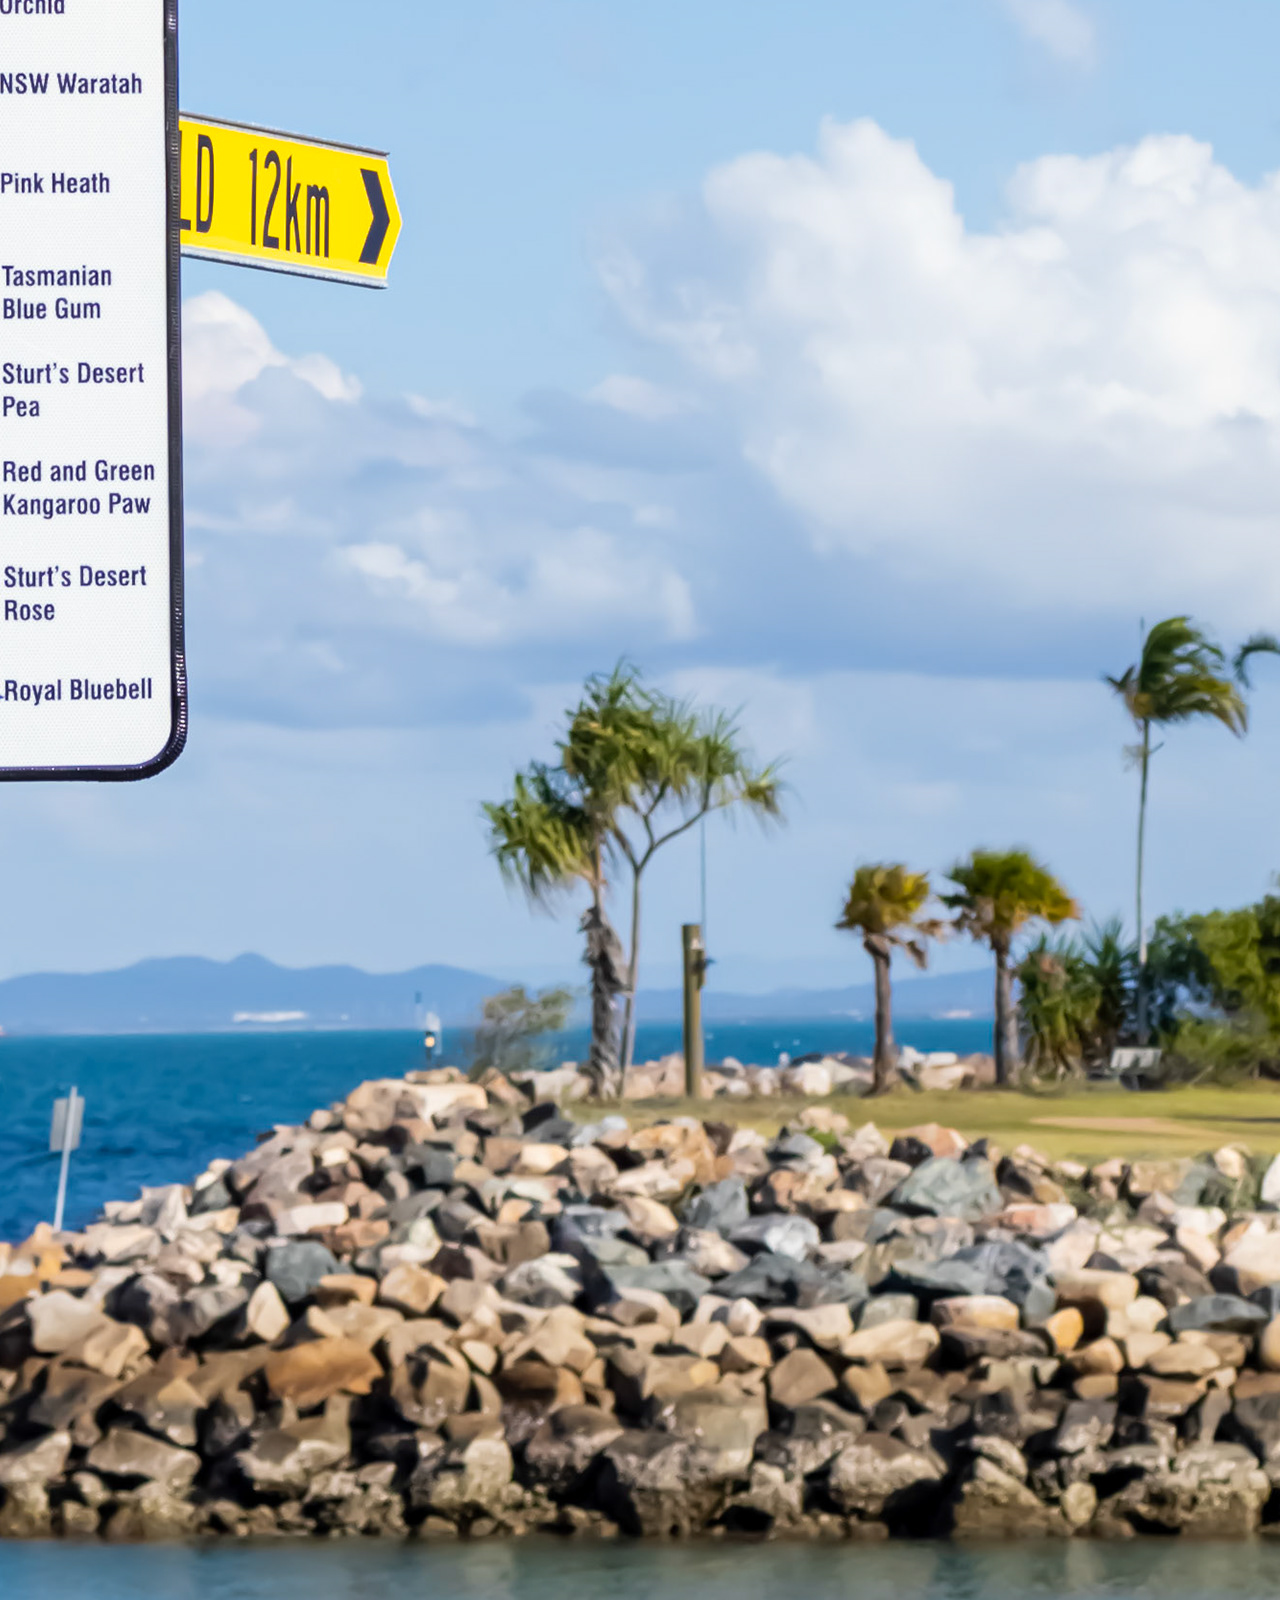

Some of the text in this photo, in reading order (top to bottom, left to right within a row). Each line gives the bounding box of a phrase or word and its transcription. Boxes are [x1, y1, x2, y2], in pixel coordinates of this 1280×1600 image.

[0, 73, 142, 94] NSW Waratah
[0, 173, 110, 193] Pink Heath
[249, 147, 330, 259] 12km
[1, 266, 112, 286] Tasmanian
[3, 298, 101, 319] Blue Gum
[77, 363, 145, 383] Desert
[2, 396, 40, 417] Pea
[2, 460, 155, 482] Red and Green
[3, 493, 151, 519] Kangaroo Paw
[79, 566, 147, 586] Desert
[4, 600, 55, 621] Rose
[4, 678, 152, 706] Royal Bluebell
